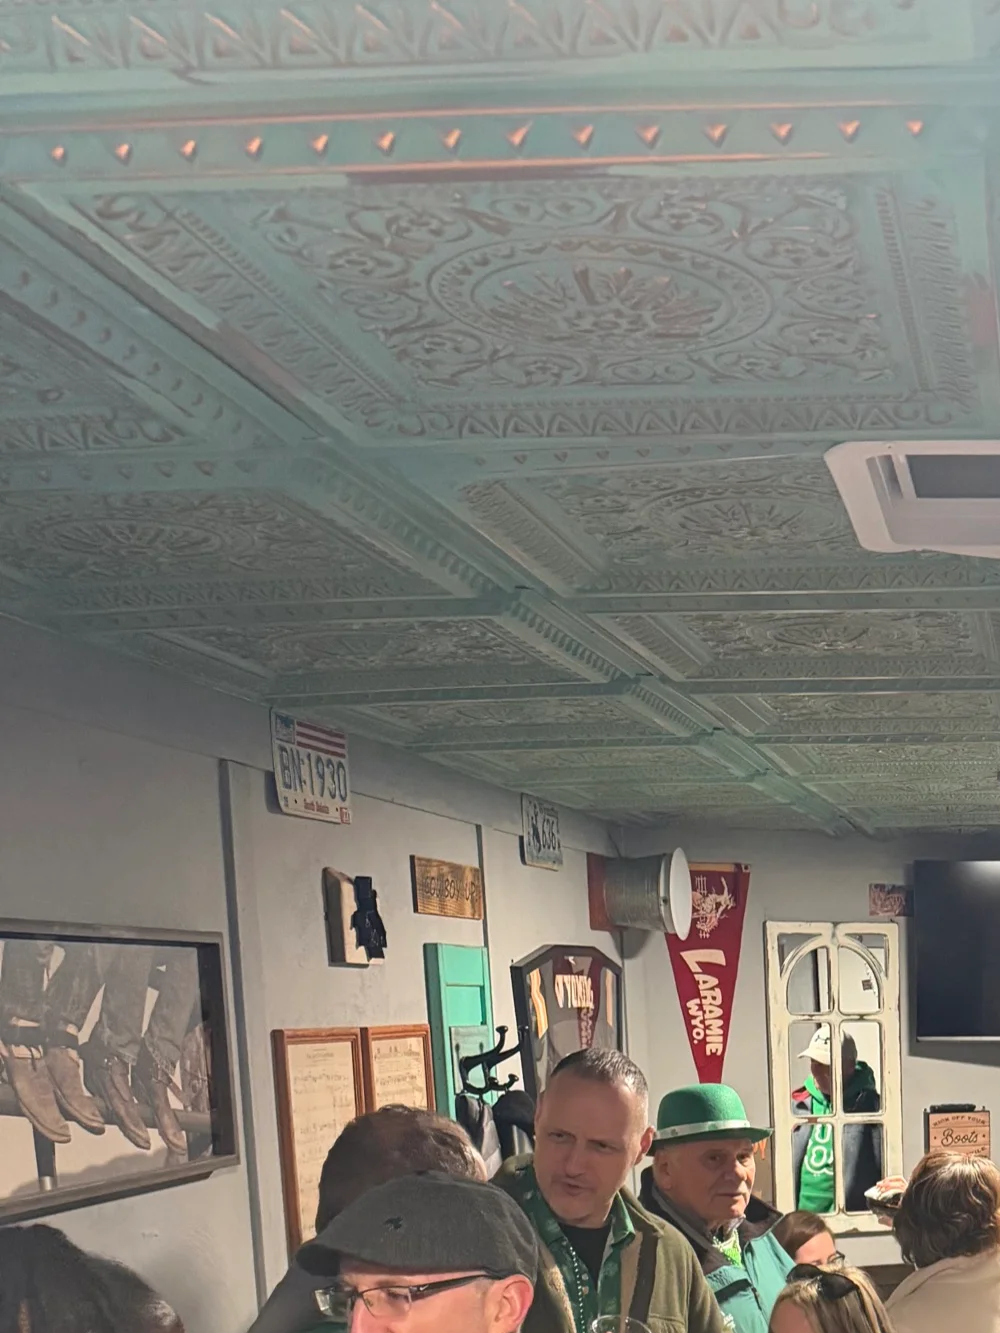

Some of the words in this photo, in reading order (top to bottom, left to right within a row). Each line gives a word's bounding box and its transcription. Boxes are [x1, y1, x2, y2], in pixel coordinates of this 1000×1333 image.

[424, 876, 460, 901] COWBOY
[680, 949, 726, 1056] LARAMIE
[686, 998, 704, 1044] WYO.
[967, 1115, 986, 1125] YOUR
[941, 1129, 978, 1147] Boots
